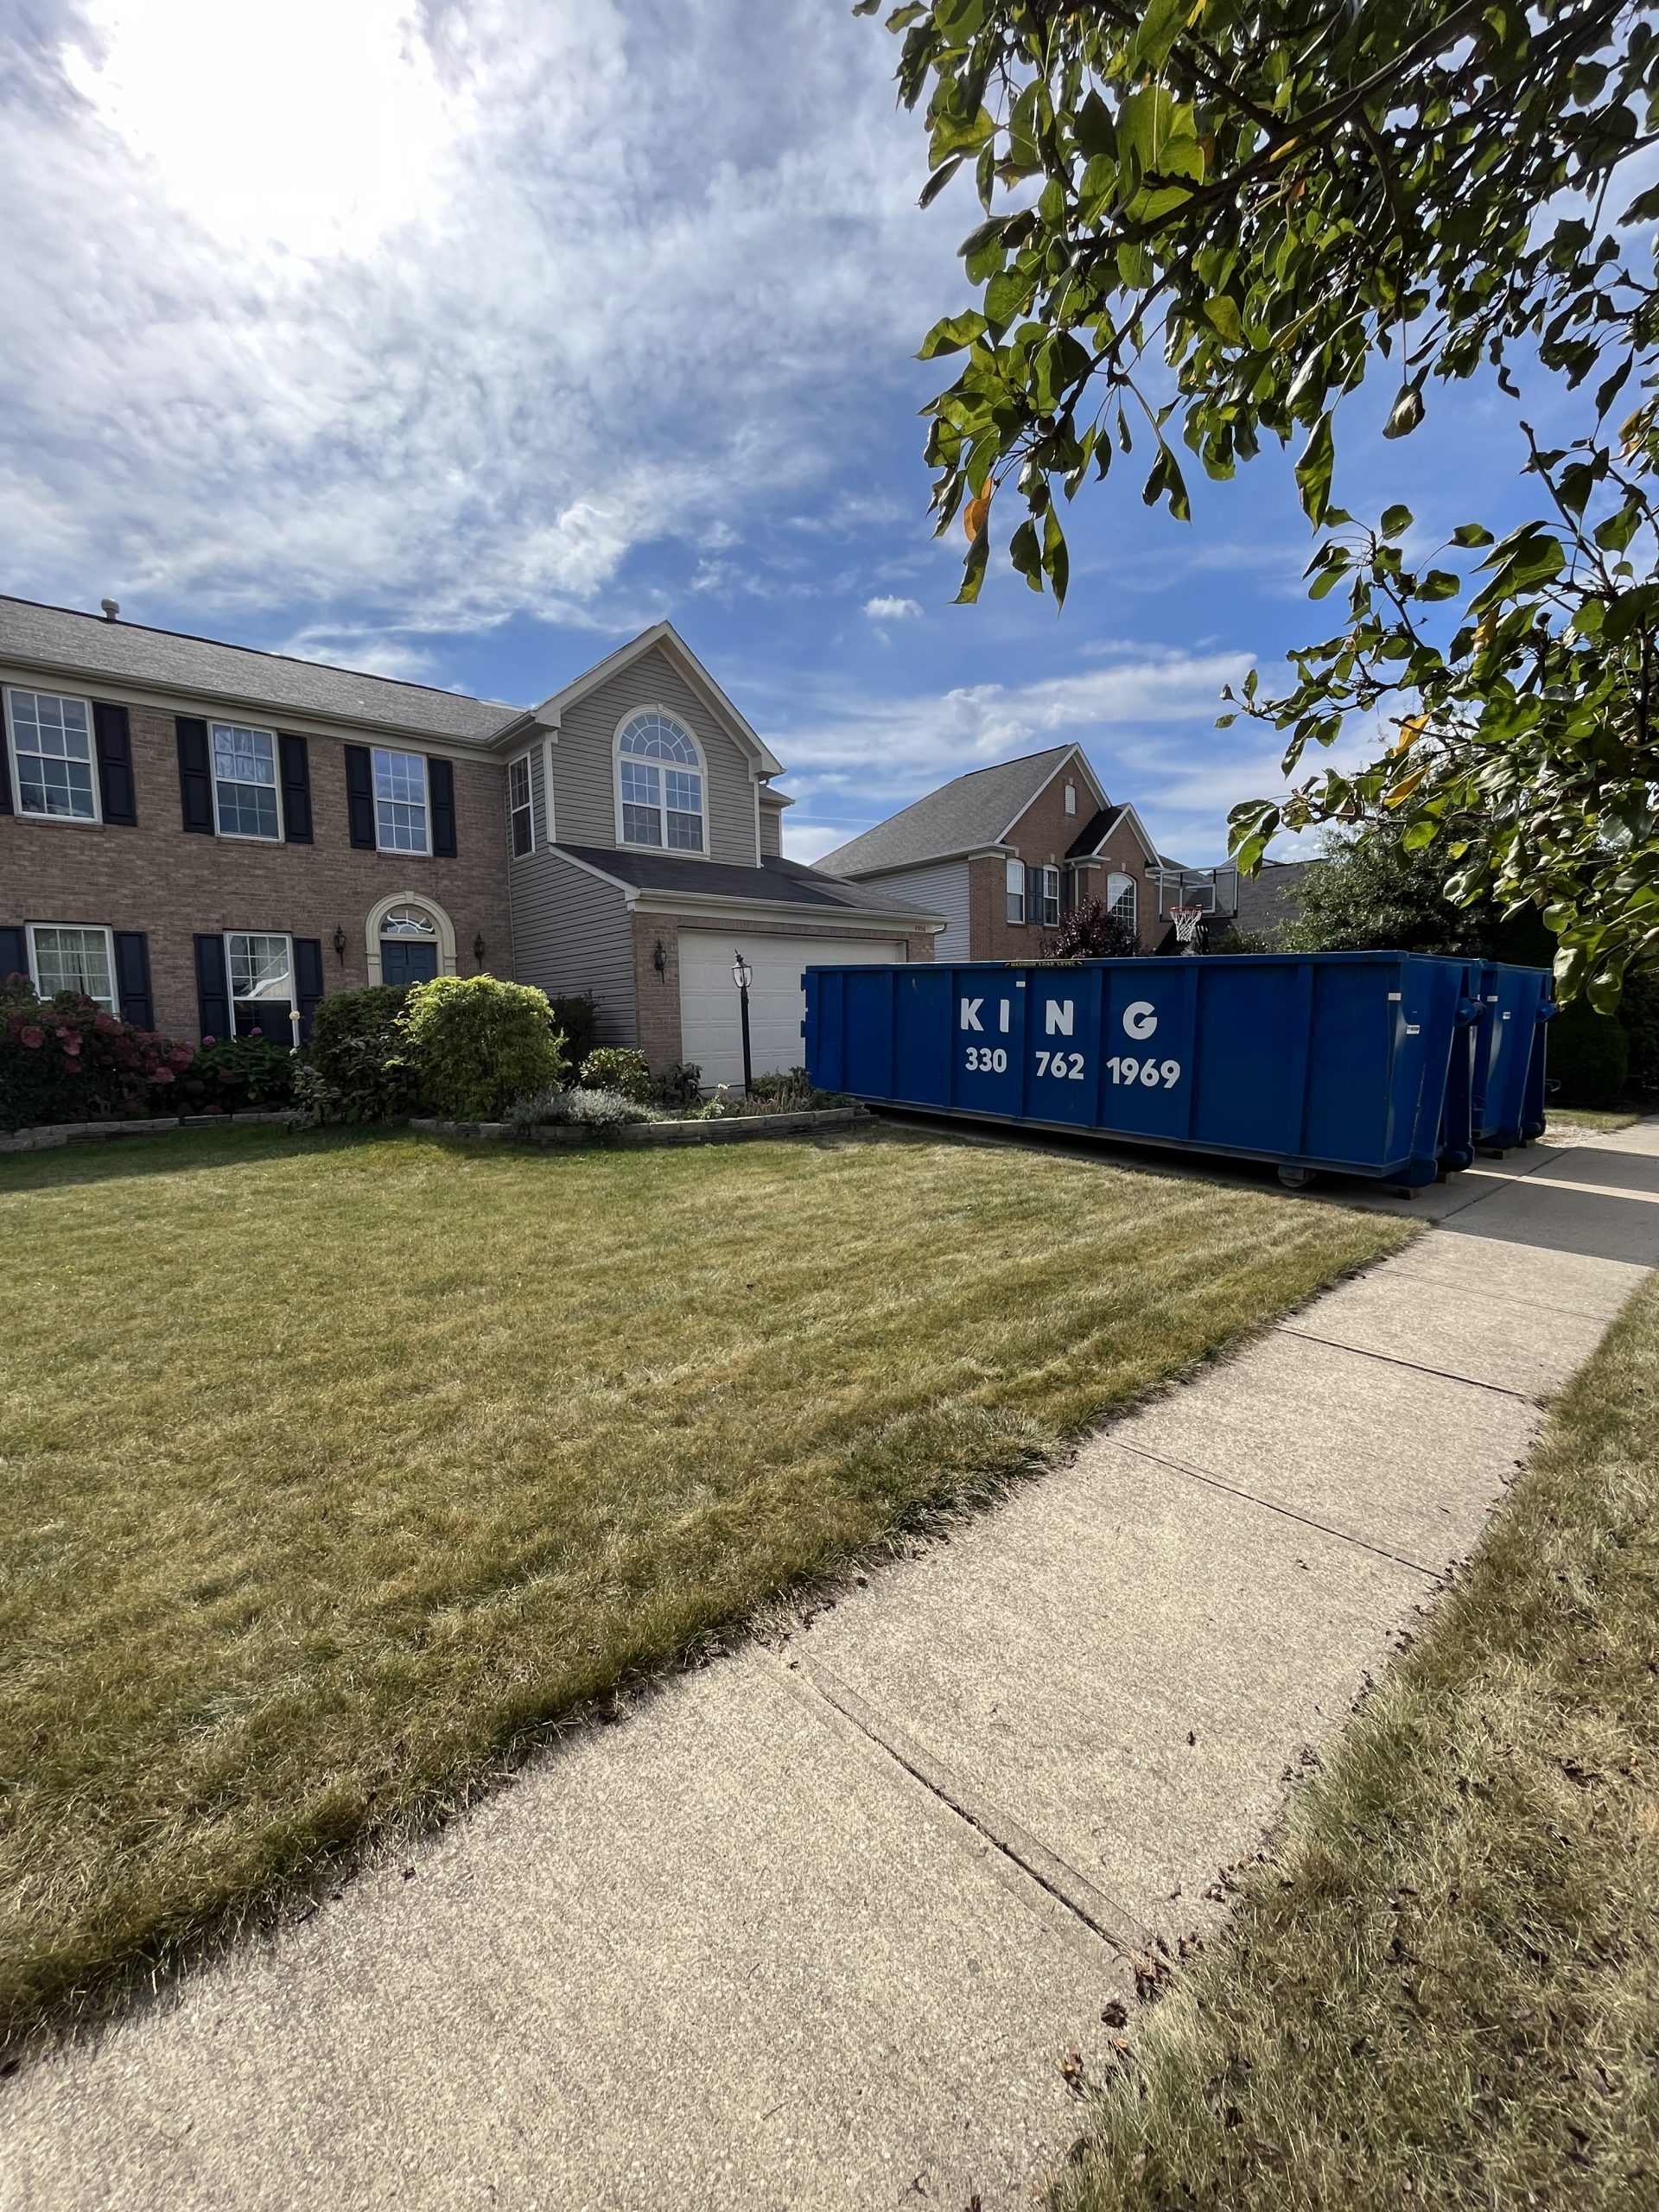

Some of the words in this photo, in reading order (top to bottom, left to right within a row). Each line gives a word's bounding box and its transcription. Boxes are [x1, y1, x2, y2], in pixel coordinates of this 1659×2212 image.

[960, 998, 1158, 1040] KING
[964, 1046, 1007, 1073] 330
[1035, 1051, 1084, 1080] 762
[1106, 1057, 1181, 1089] 1969
